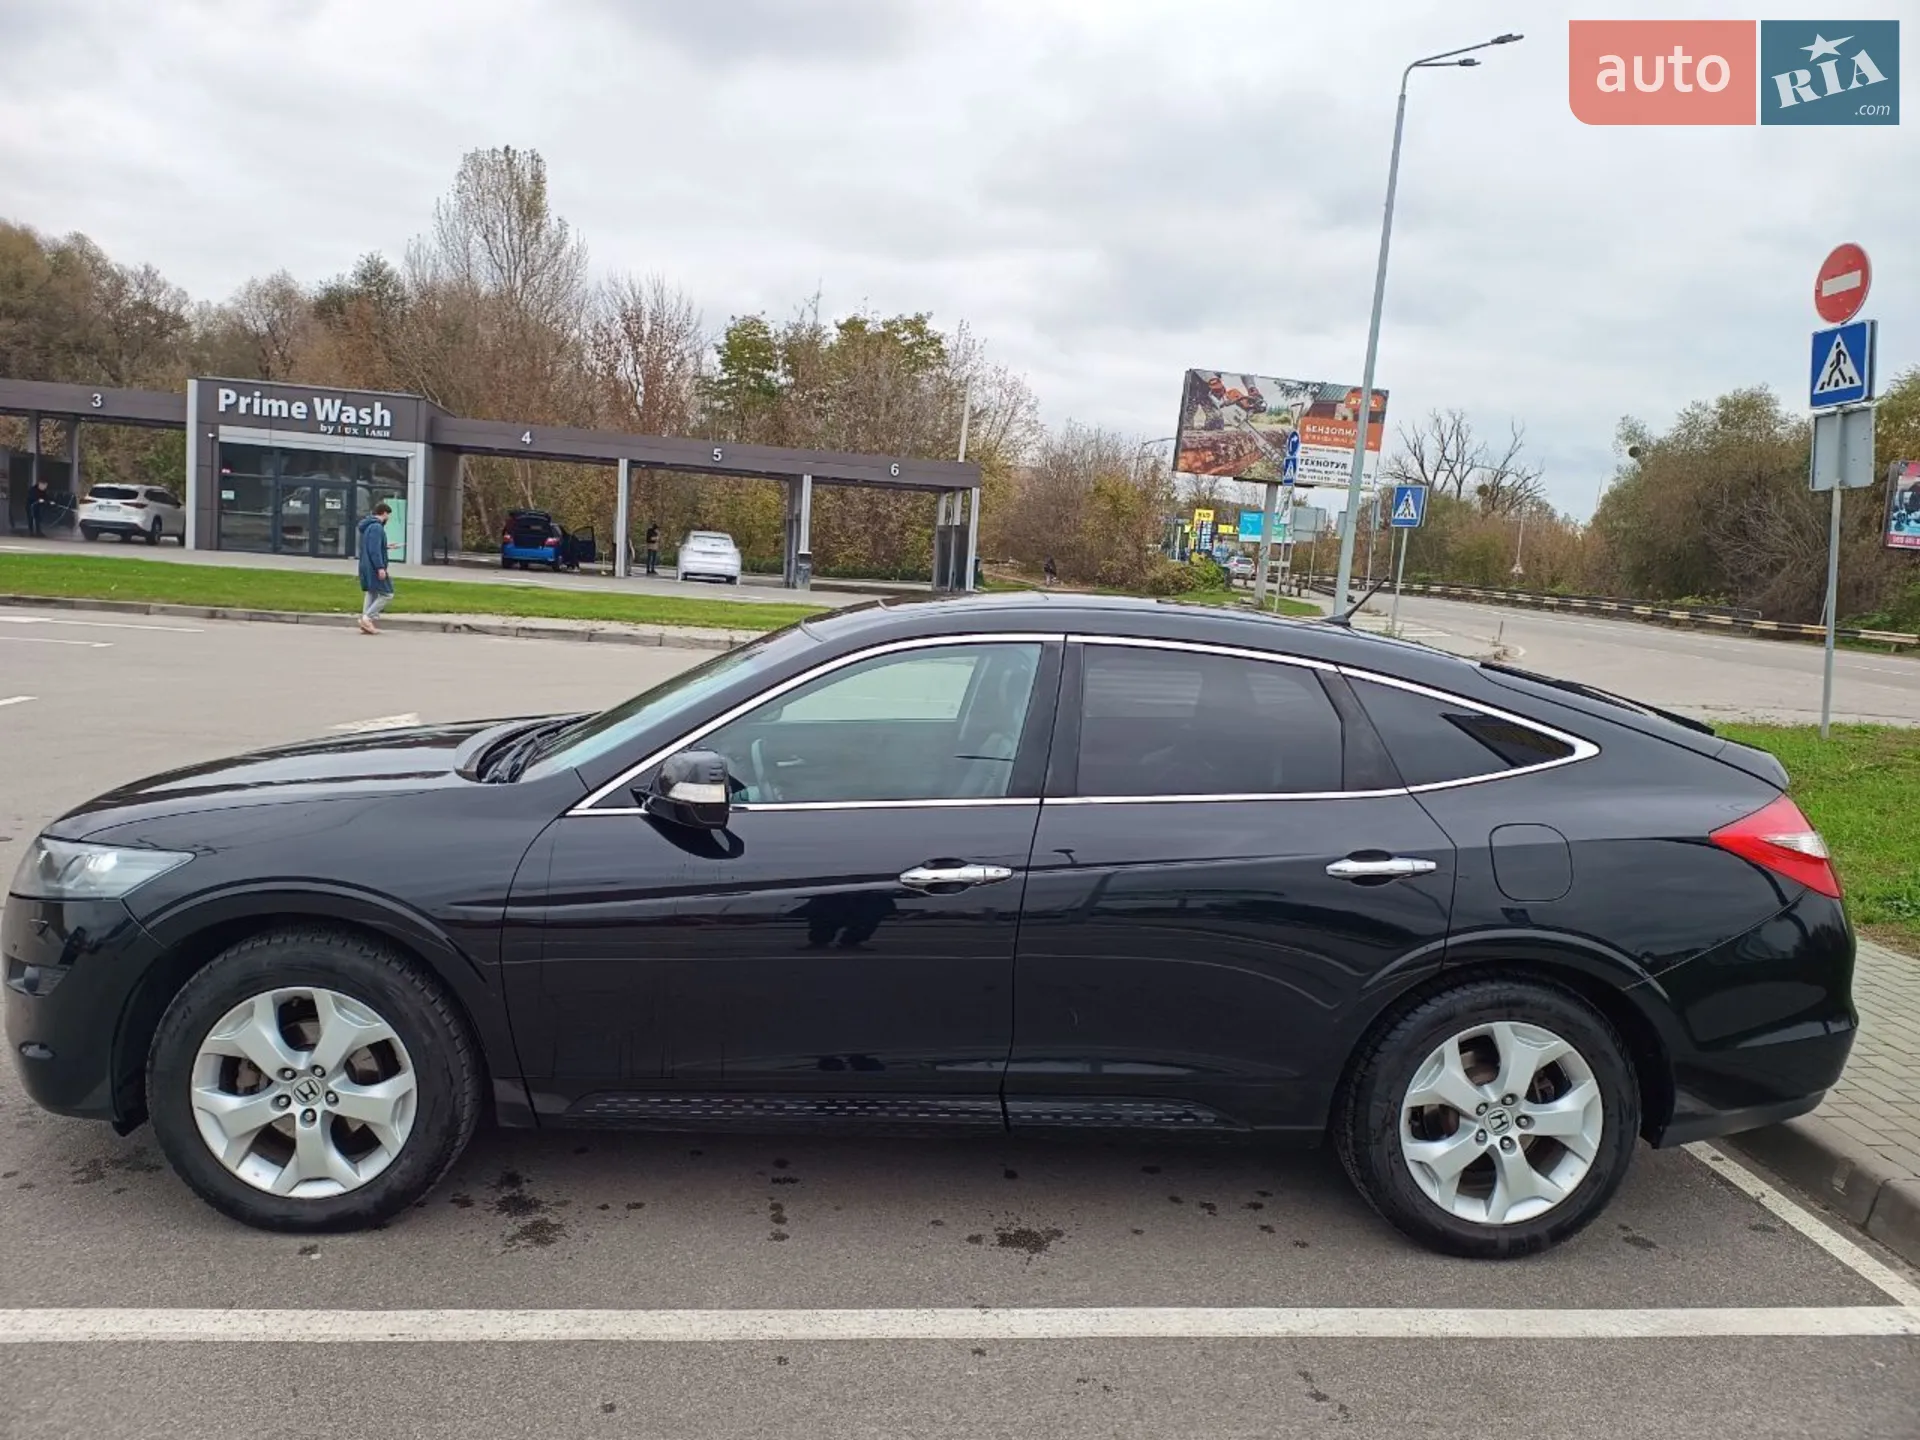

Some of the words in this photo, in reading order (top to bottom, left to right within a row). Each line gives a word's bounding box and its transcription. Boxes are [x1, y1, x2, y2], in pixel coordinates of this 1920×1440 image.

[91, 393, 102, 408] 3
[218, 387, 308, 420] Prime
[313, 396, 391, 427] Wash
[1349, 395, 1378, 408] STL
[320, 423, 334, 434] by
[1305, 423, 1358, 437] БЕНЗОПИЛ
[521, 431, 532, 445] 4
[712, 447, 723, 462] 5
[889, 463, 899, 477] 6
